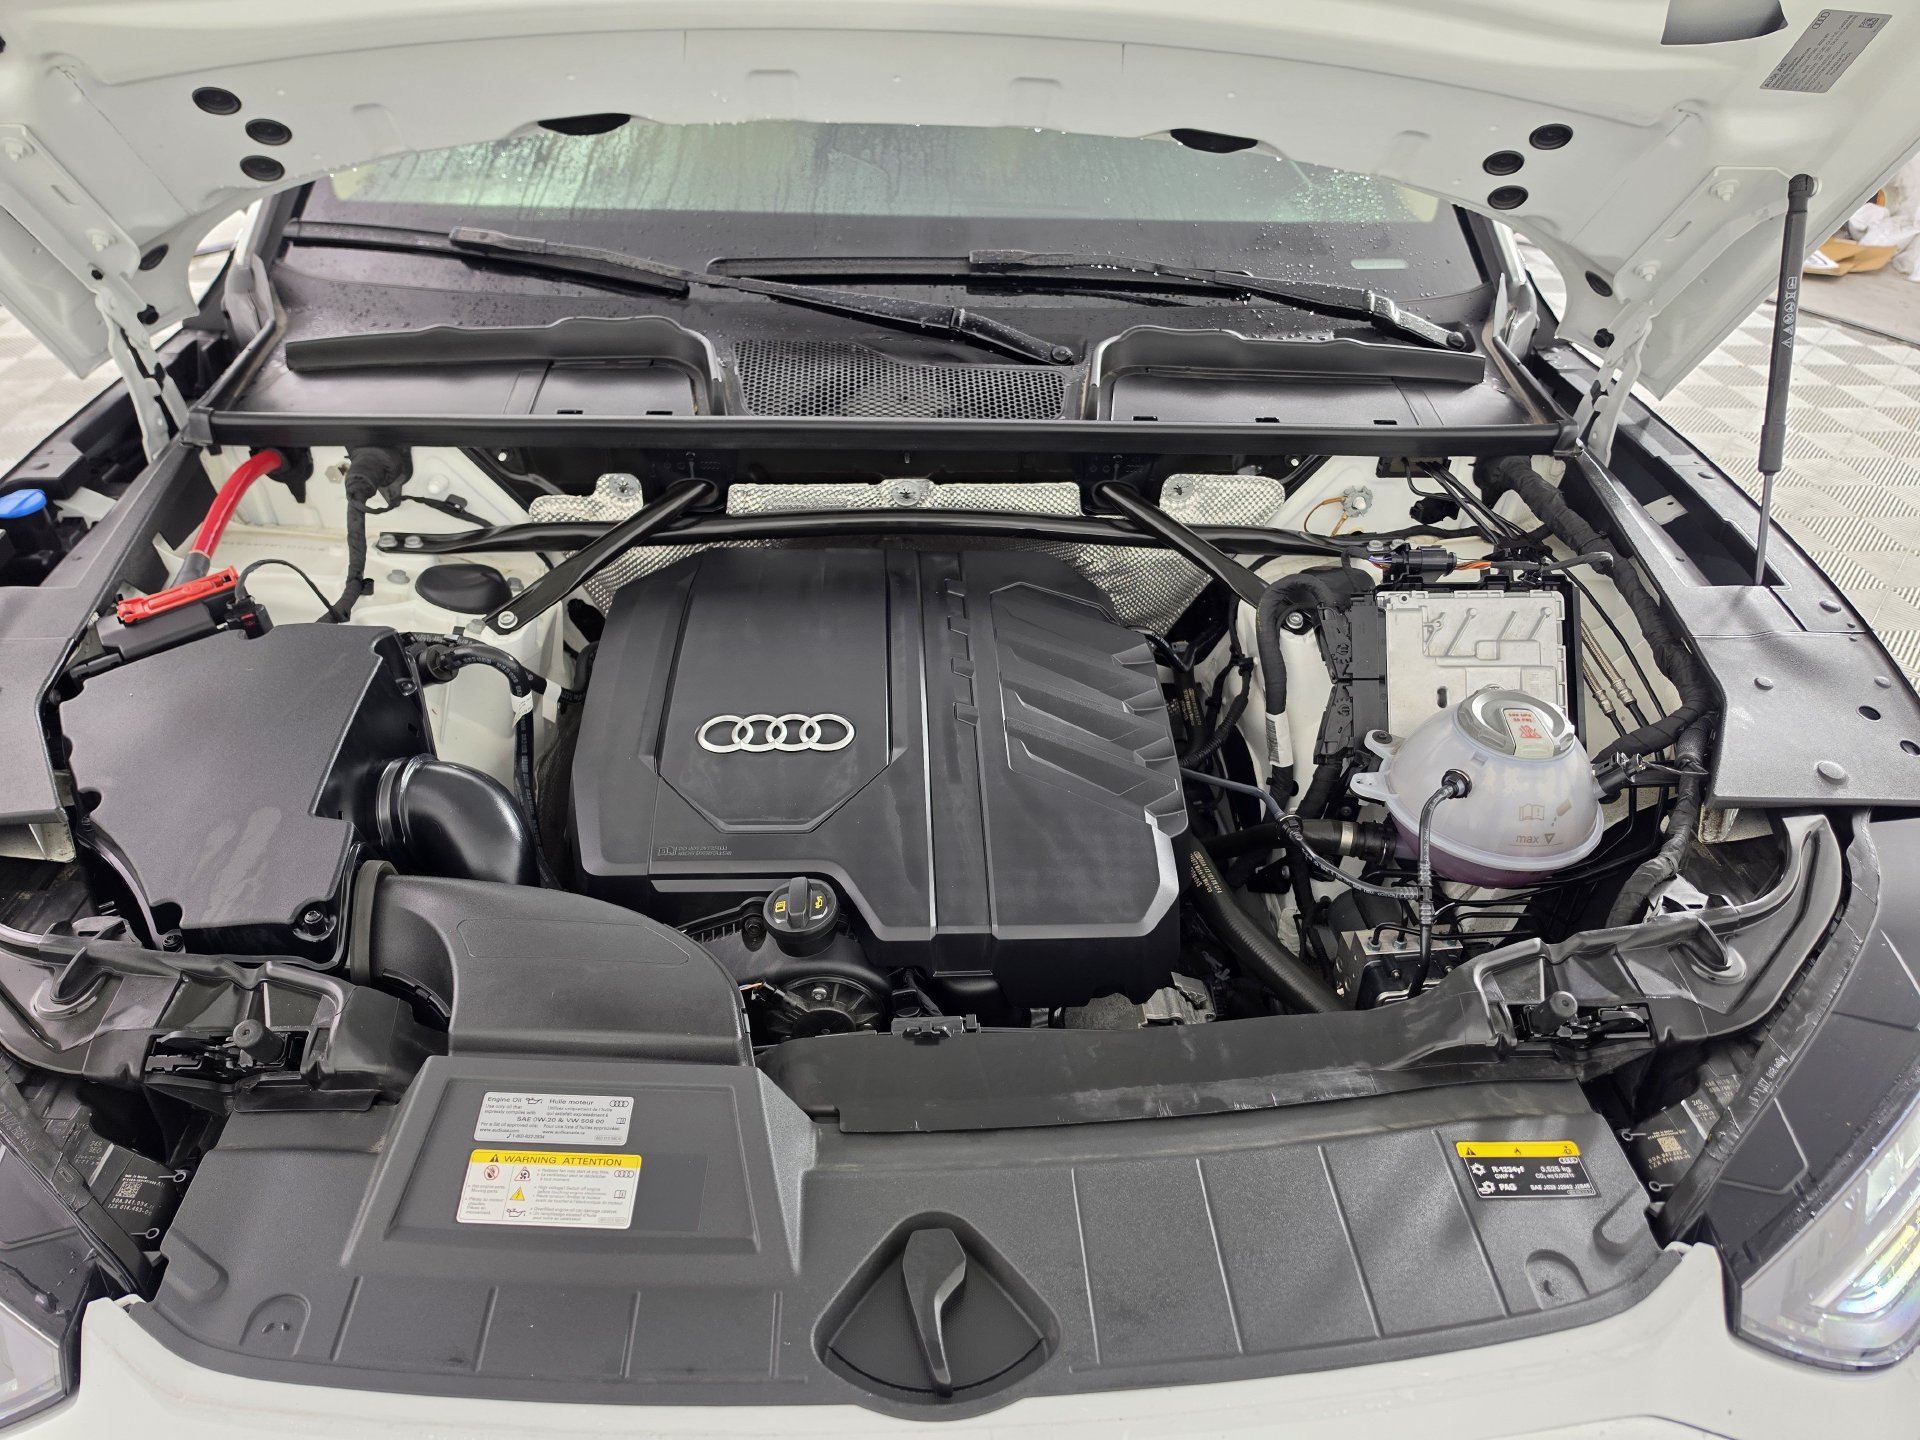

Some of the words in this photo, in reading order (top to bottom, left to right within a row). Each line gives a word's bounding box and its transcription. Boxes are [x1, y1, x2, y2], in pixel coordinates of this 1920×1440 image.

[1515, 834, 1540, 844] max
[504, 1155, 557, 1164] WARNING
[562, 1157, 622, 1166] ATTENTION
[1491, 1165, 1525, 1174] R-1234yf
[1498, 1183, 1518, 1191] PAG
